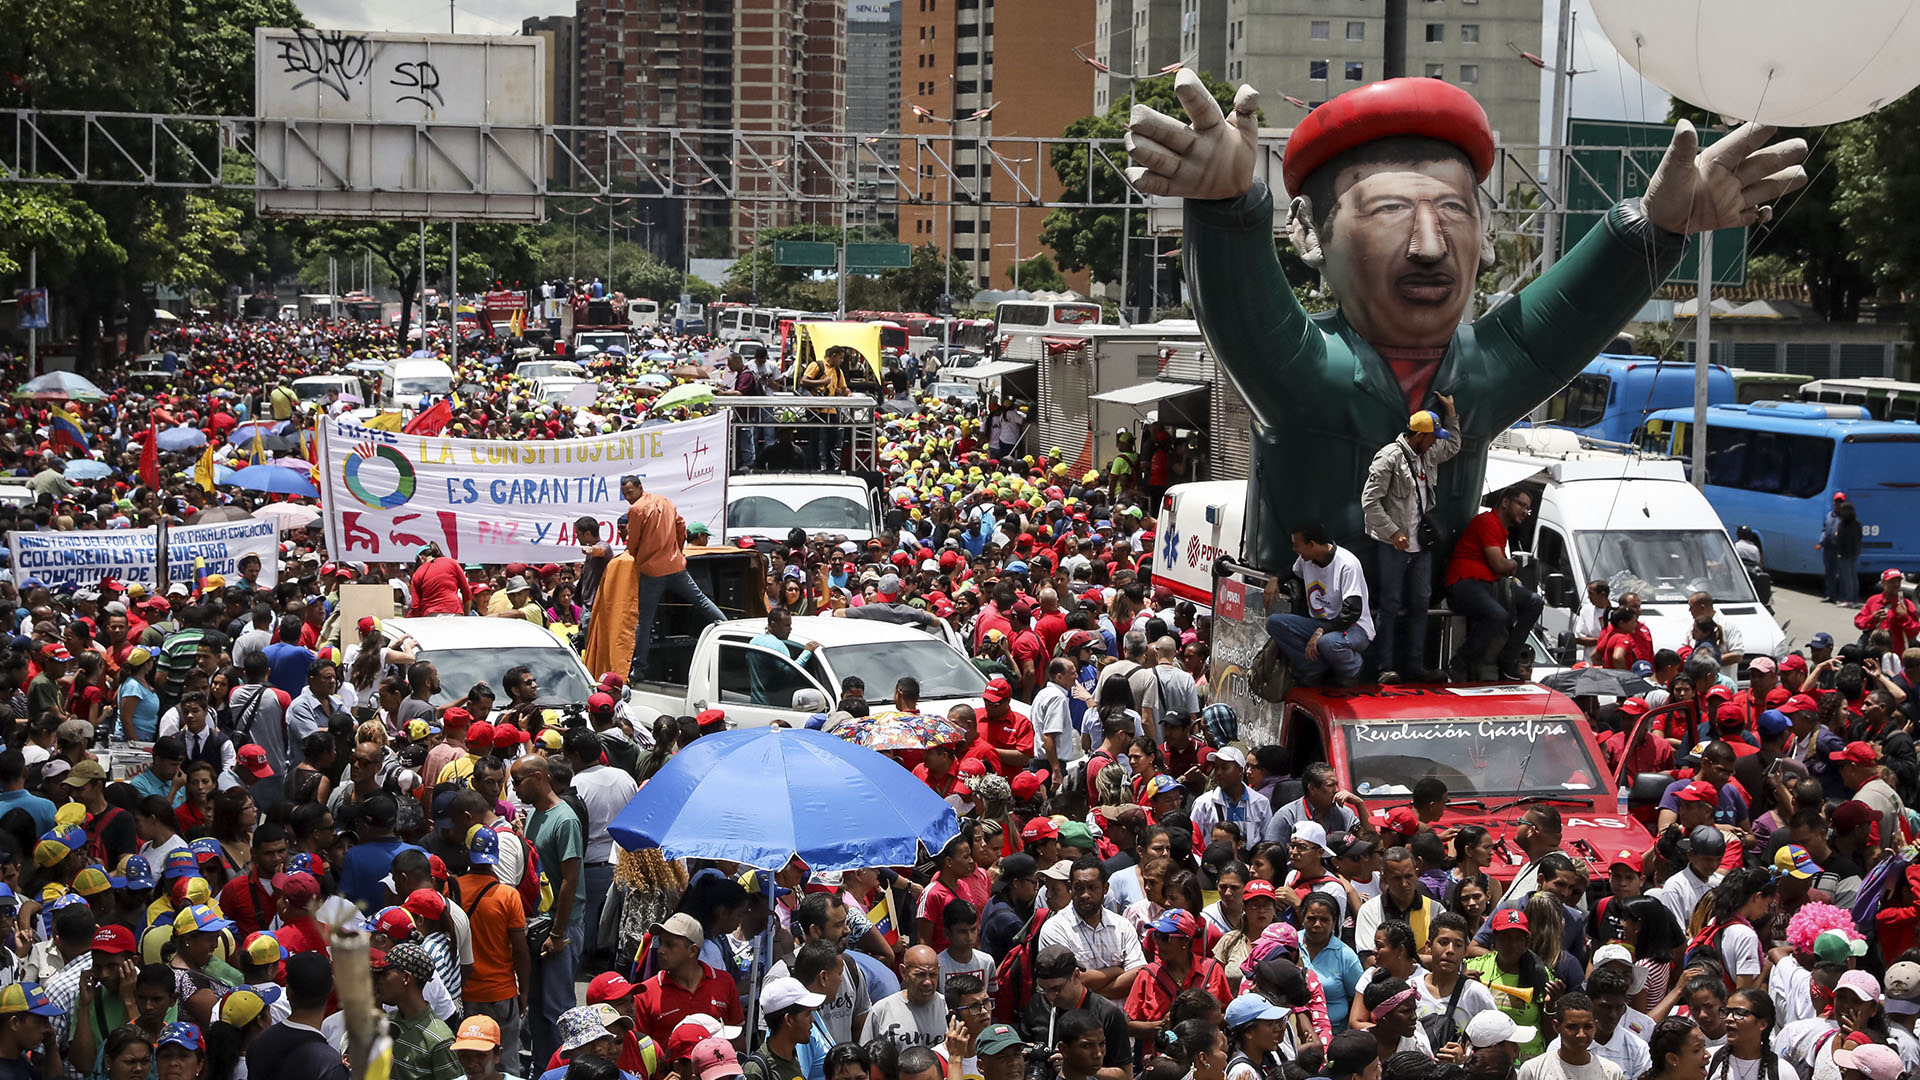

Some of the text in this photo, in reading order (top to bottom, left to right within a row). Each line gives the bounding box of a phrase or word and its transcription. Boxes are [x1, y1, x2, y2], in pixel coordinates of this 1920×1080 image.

[419, 439, 456, 465] LA
[447, 477, 479, 504] ES
[489, 473, 609, 504] GARANTÍA
[19, 535, 81, 548] MINISTERIO
[83, 536, 104, 547] DEL
[105, 535, 137, 547] PODER
[228, 520, 274, 539] EDUCACIÓN
[478, 520, 519, 545] PAZ
[1861, 524, 1880, 538] 89
[112, 547, 133, 564] LA
[127, 566, 150, 581] DE
[1199, 562, 1209, 573] GAS
[1226, 589, 1241, 605] PDVSA
[1355, 719, 1567, 743] Revolución Gasífera
